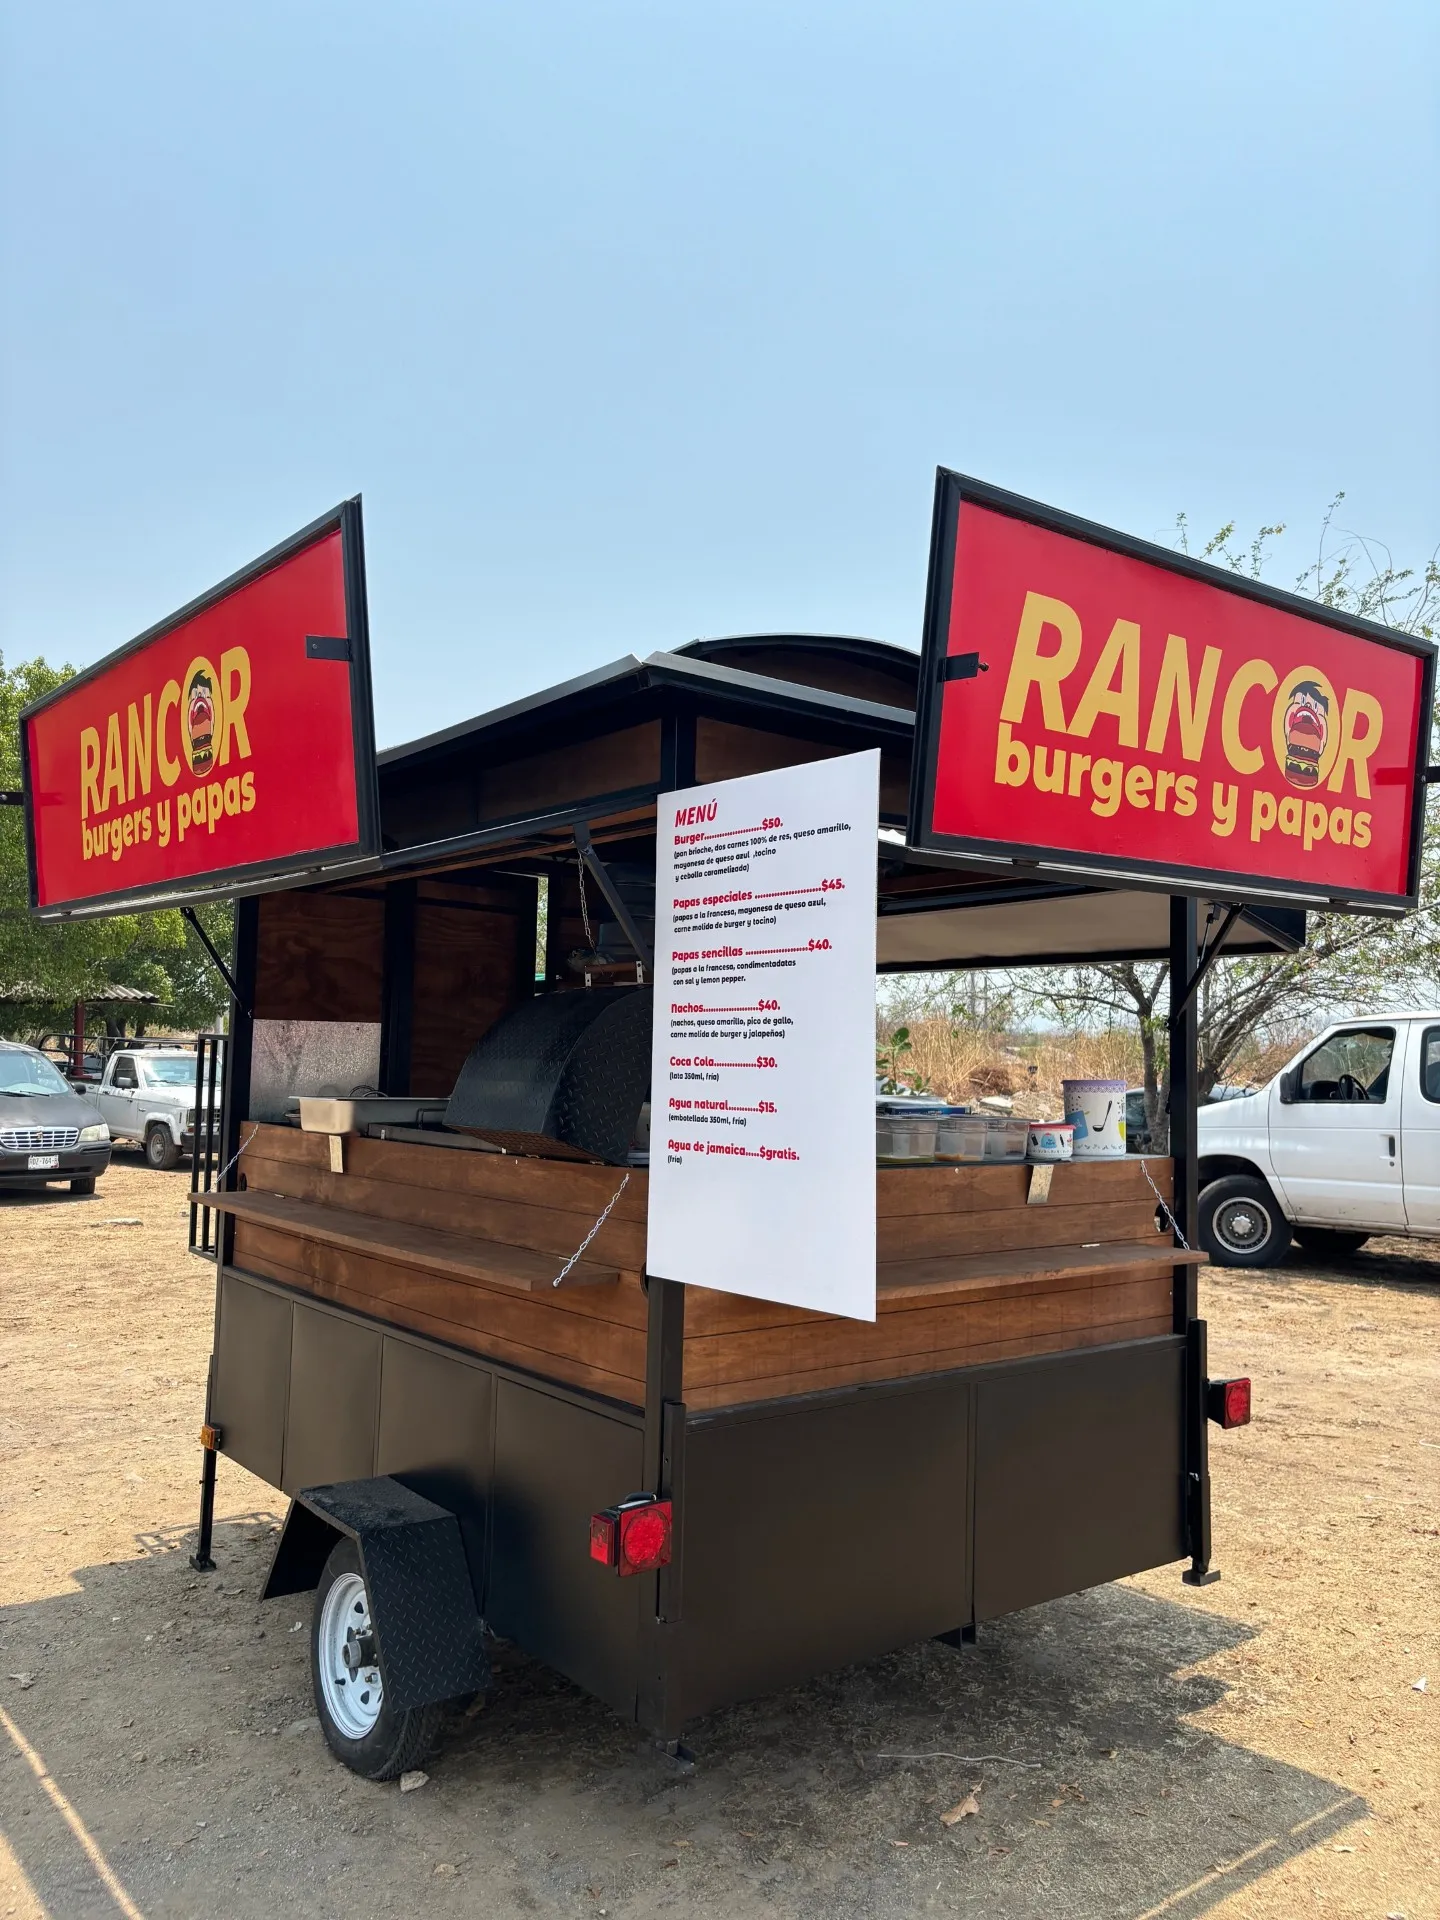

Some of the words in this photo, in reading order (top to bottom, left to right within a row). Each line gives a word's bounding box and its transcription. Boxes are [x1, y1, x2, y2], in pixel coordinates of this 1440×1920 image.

[998, 590, 1384, 800] RANCOR
[80, 646, 251, 820] RANCOR
[994, 720, 1198, 817] burgers
[1211, 779, 1238, 838] y
[1250, 788, 1372, 851] papas
[81, 807, 152, 862] burgers
[157, 800, 171, 848] y
[178, 771, 257, 842] papas
[675, 798, 718, 828] MENÚ
[673, 851, 687, 860] (pan
[688, 846, 713, 856] brioche,
[714, 844, 726, 852] dos
[727, 840, 749, 849] carnes
[750, 836, 767, 846] 100%
[768, 835, 777, 843] de
[779, 833, 792, 841] res,
[793, 829, 815, 840] queso
[817, 823, 851, 835] amarillo,
[673, 859, 705, 870] mayonesa
[706, 857, 714, 865] de
[715, 854, 735, 864] queso
[735, 851, 750, 860] azul
[680, 871, 703, 880] cebolla
[704, 863, 750, 876] caramelizada)
[673, 899, 701, 910] Papas
[702, 891, 753, 906] especiales
[673, 914, 693, 923] (papas
[707, 909, 737, 918] francesa,
[738, 904, 773, 915] mayonesa
[774, 902, 783, 910] de
[784, 901, 806, 911] queso
[808, 898, 827, 908] azul,
[692, 922, 713, 931] molida
[724, 920, 746, 929] burger
[753, 916, 777, 926] tocino)
[672, 951, 699, 962] Papas
[701, 946, 743, 959] sencillas
[671, 967, 692, 975] (papas
[705, 963, 736, 972] francesa,
[685, 977, 695, 985] sal
[695, 978, 700, 986] y
[700, 976, 720, 984] lemon
[721, 975, 746, 984] pepper.
[670, 1019, 696, 1027] (nachos,
[716, 1017, 746, 1026] amarillo,
[747, 1016, 762, 1026] pico
[762, 1017, 772, 1025] de
[773, 1016, 794, 1026] gallo,
[688, 1029, 710, 1038] molida
[710, 1030, 719, 1038] de
[720, 1030, 742, 1039] burger
[743, 1031, 748, 1039] y
[748, 1029, 786, 1039] jalapeños)
[670, 1056, 692, 1067] Coca
[669, 1072, 684, 1080] (lata
[684, 1072, 705, 1081] 350ml,
[669, 1098, 692, 1110] Agua
[668, 1113, 709, 1123] (embotellada
[709, 1116, 731, 1125] 350ml,
[668, 1139, 691, 1152] Agua
[693, 1141, 705, 1152] de
